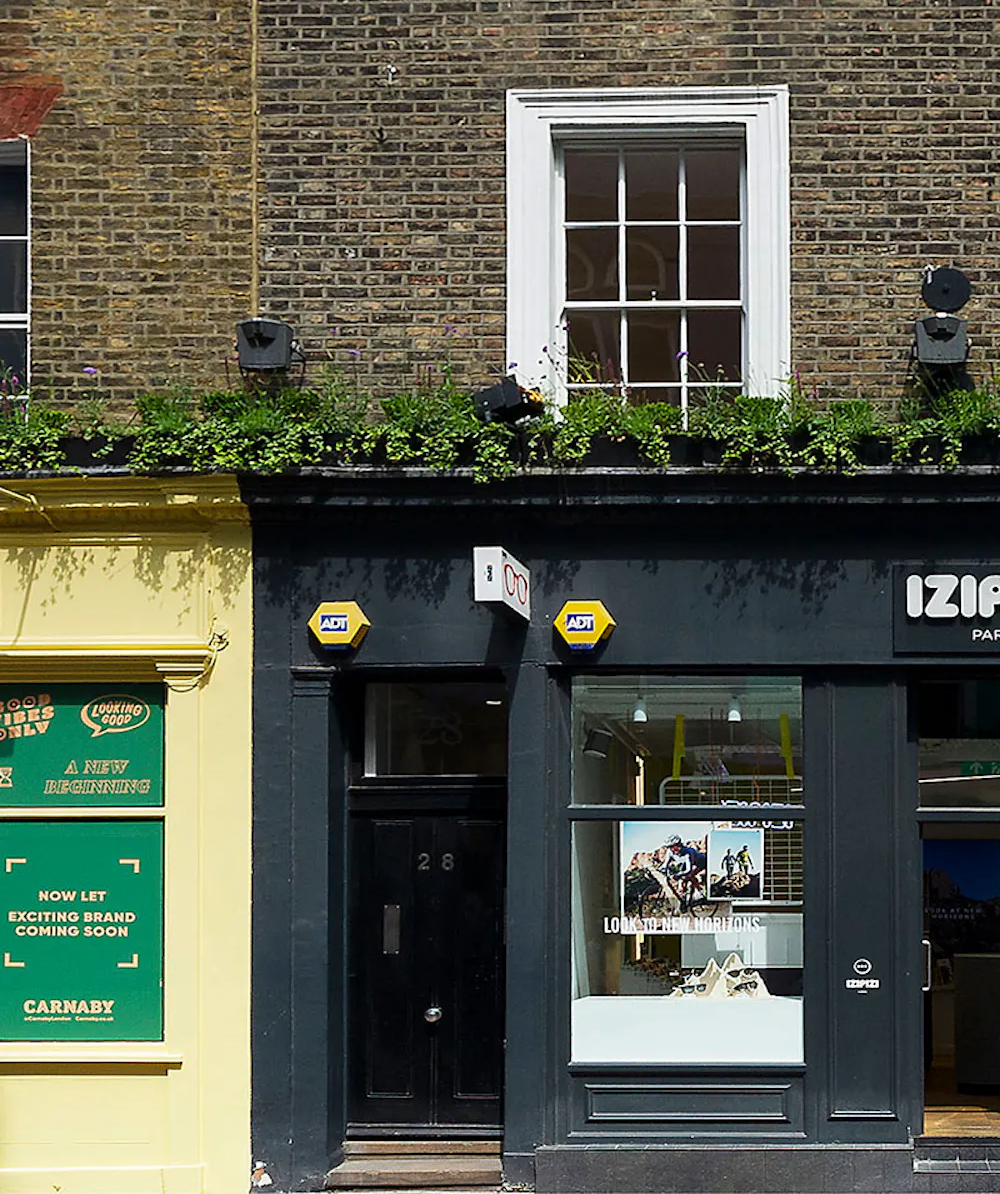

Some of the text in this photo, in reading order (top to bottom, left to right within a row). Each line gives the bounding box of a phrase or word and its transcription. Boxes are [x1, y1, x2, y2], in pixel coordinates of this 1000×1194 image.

[319, 616, 348, 630] ADT
[566, 615, 594, 630] ADT
[0, 705, 55, 726] IBES
[91, 700, 144, 718] LOOKING
[101, 714, 132, 726] GOOD
[64, 760, 130, 774] A NEW
[43, 779, 151, 794] BEGINNING
[38, 890, 107, 902] NOW LET
[8, 911, 136, 923] EXCITING BRAND
[15, 925, 128, 937] COMING SOON
[603, 917, 761, 934] LOOK TO NEW HORIZONS
[23, 999, 115, 1014] CARNABY
